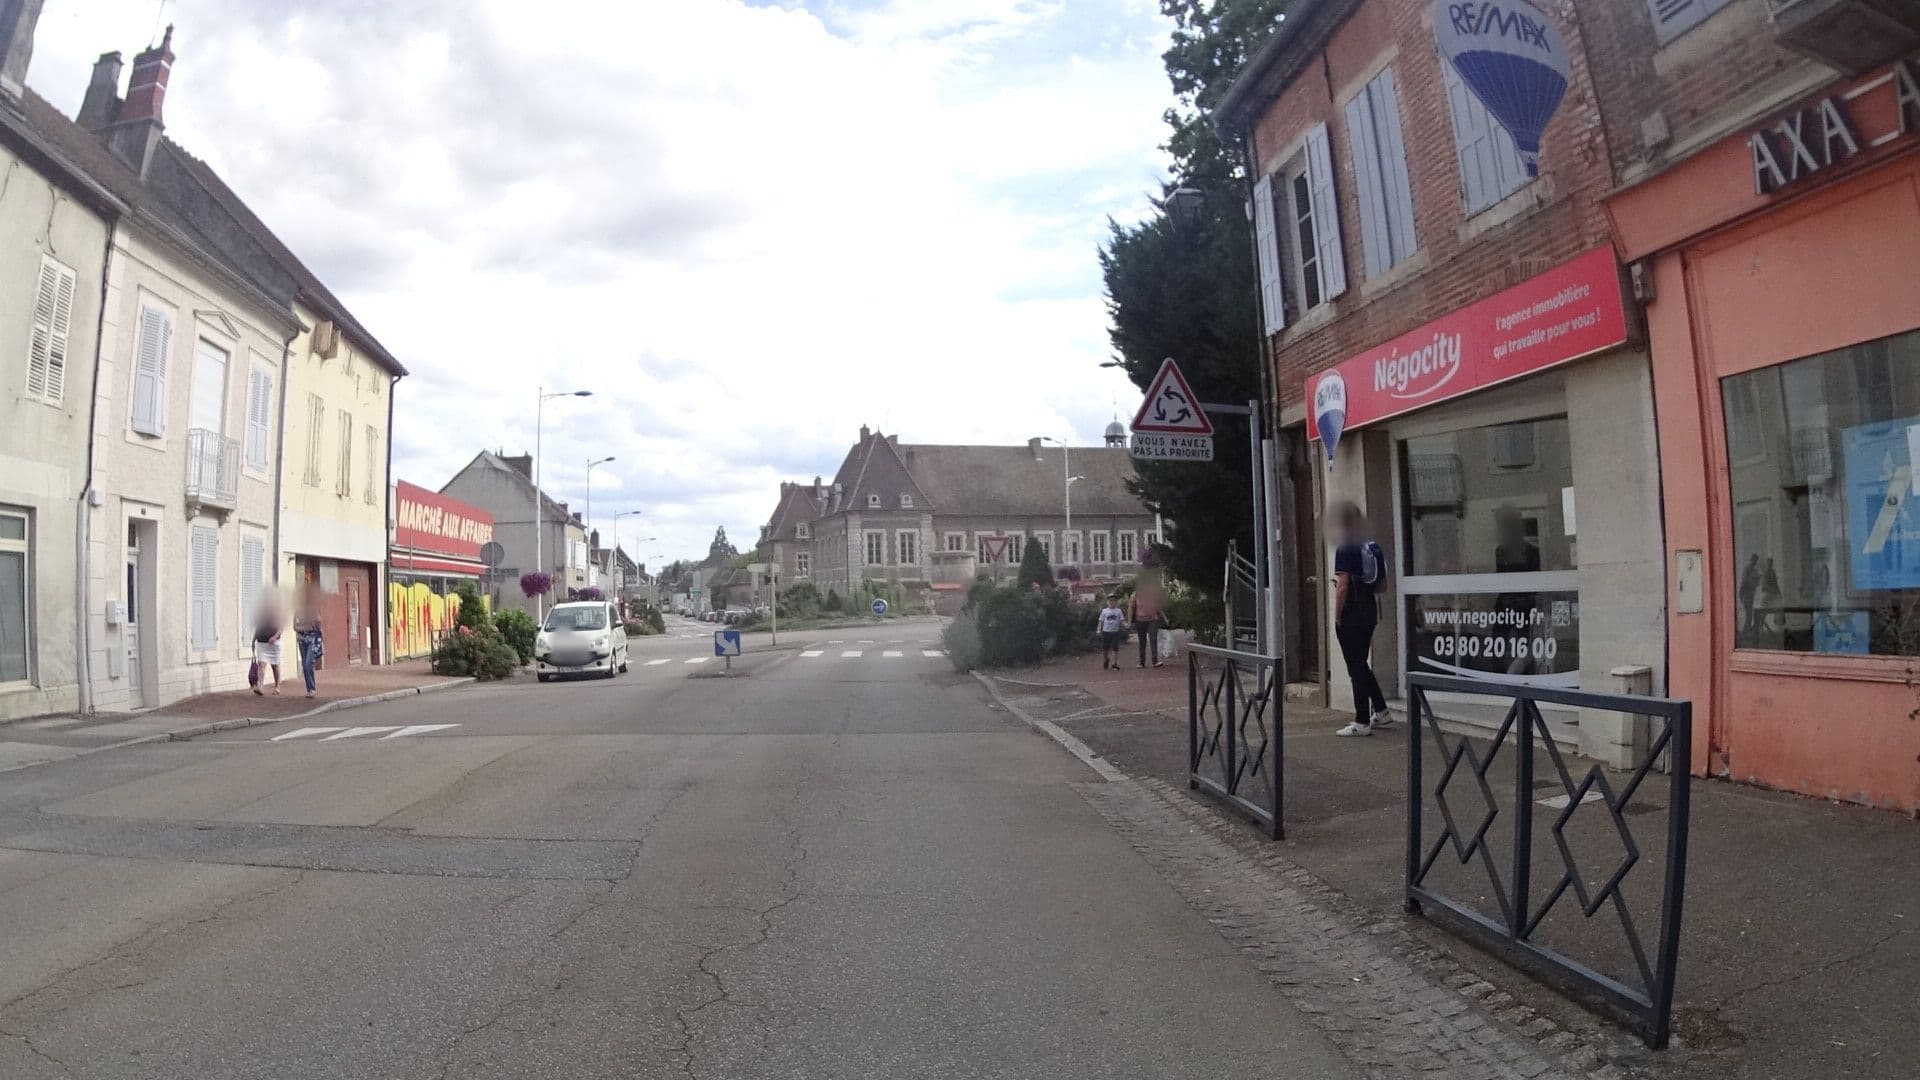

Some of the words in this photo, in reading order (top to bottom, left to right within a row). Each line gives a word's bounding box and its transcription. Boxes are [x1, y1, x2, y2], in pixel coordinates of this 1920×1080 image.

[1449, 2, 1551, 52] RE/MAX
[1747, 98, 1858, 194] AXA
[1495, 307, 1532, 330] l'agence
[1532, 284, 1590, 316] immobilière
[1493, 344, 1508, 360] qui
[1508, 328, 1546, 353] travaille
[1546, 322, 1570, 342] pour
[1571, 312, 1596, 330] vous
[1374, 332, 1461, 392] Négocity
[1133, 446, 1152, 456] PAS
[1154, 448, 1167, 457] LA
[1137, 436, 1165, 446] VOUS
[1171, 438, 1207, 448] N'AVEZ
[441, 511, 461, 540] AUX
[459, 516, 494, 546] AFFAIRES
[1424, 607, 1544, 629] www.negocity.fr
[1433, 635, 1455, 657] 03
[1457, 636, 1480, 657] 80
[1483, 636, 1506, 658] 20
[1508, 637, 1528, 659] 16
[1531, 637, 1558, 659] 00
